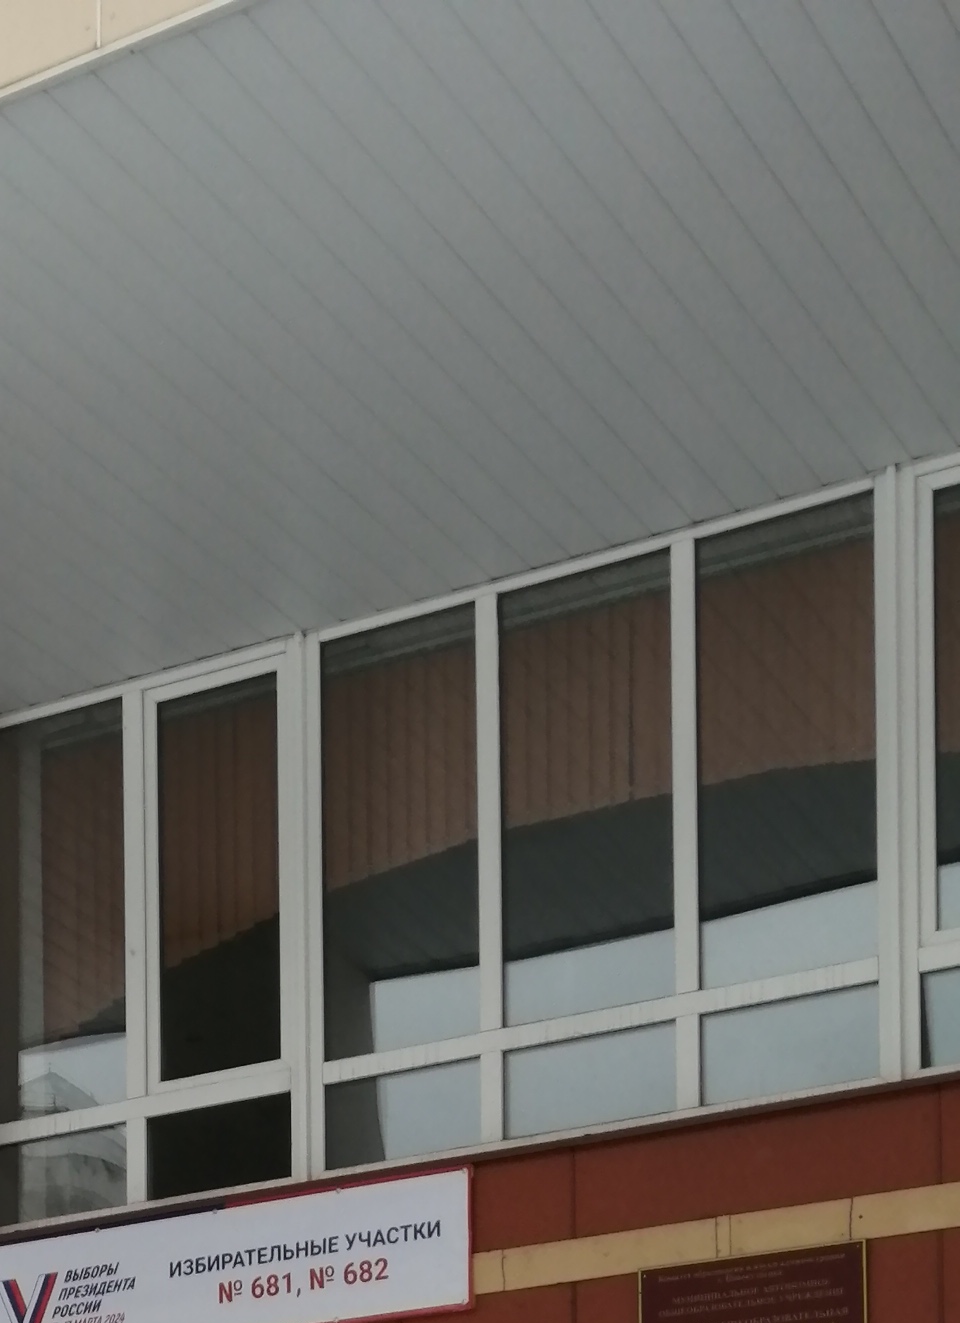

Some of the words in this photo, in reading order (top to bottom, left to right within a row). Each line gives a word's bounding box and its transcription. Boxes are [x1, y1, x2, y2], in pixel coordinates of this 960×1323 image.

[169, 1235, 339, 1278] ИЗБИРАТЕЛЬНЫЕ
[345, 1219, 441, 1251] УЧАСТКИ
[64, 1262, 120, 1283] ВЫБОРЫ
[218, 1279, 243, 1304] №
[251, 1272, 302, 1298] 681,
[309, 1265, 335, 1291] №
[343, 1257, 390, 1285] 682
[58, 1276, 136, 1301] ПРЕЗИДЕНТА
[52, 1299, 102, 1319] РОССИИ
